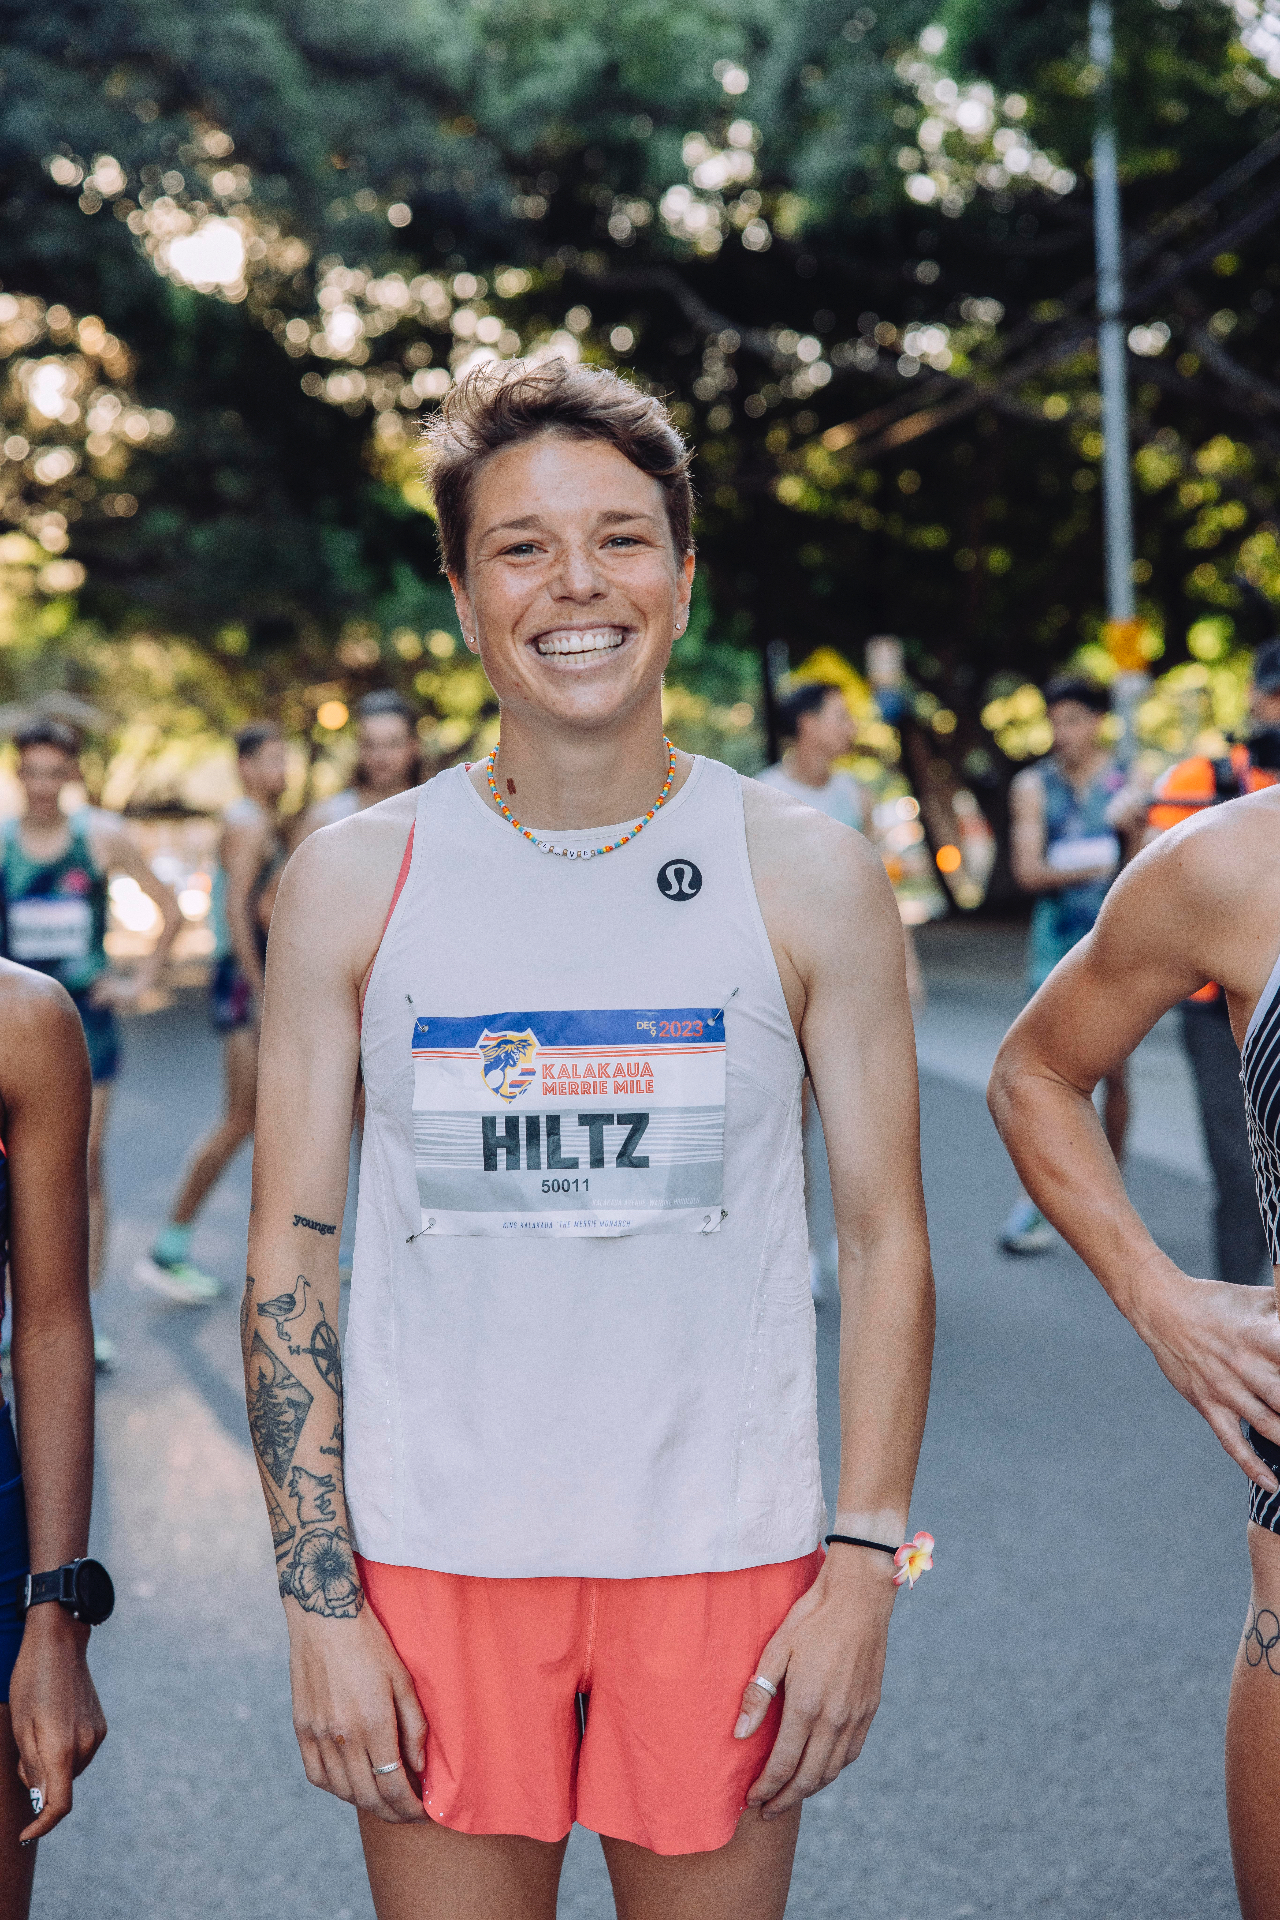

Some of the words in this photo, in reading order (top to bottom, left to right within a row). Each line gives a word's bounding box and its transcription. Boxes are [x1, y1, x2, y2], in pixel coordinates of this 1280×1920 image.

[636, 1021, 656, 1030] DEC
[650, 1029, 656, 1037] 9
[659, 1020, 703, 1037] 2023
[542, 1062, 654, 1079] KALAKAUA
[542, 1080, 608, 1096] MERRIE
[613, 1079, 654, 1095] MILE
[482, 1112, 650, 1171] HILTZ
[541, 1178, 589, 1193] 50011
[292, 1214, 337, 1235] younger
